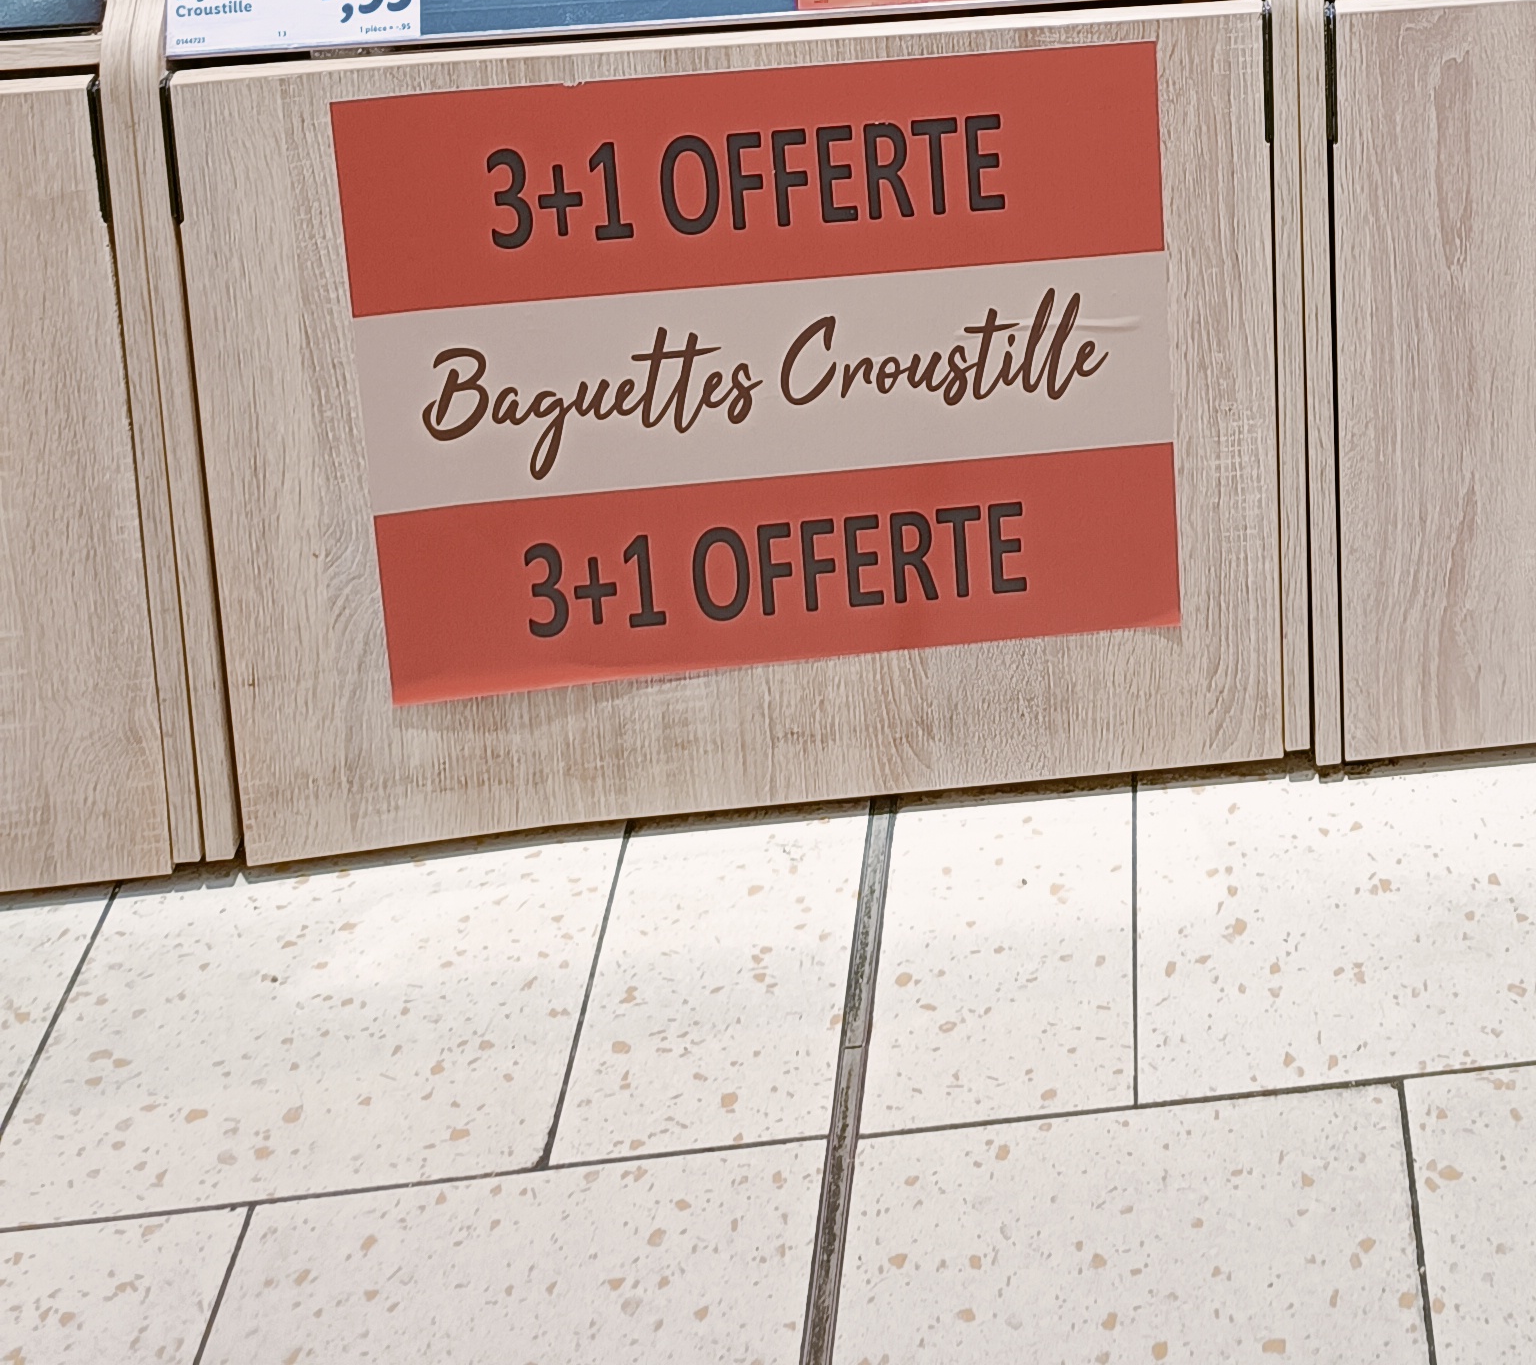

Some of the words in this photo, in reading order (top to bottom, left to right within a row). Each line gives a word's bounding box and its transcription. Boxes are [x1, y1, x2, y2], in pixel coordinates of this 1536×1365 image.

[176, 0, 252, 18] Croustille
[485, 141, 634, 250] 3+1
[660, 113, 1006, 237] OFFERTE
[421, 325, 762, 481] Baguettes
[779, 286, 1109, 407] Croustille
[522, 532, 668, 638] 3+1
[691, 501, 1029, 622] OFFERTE
